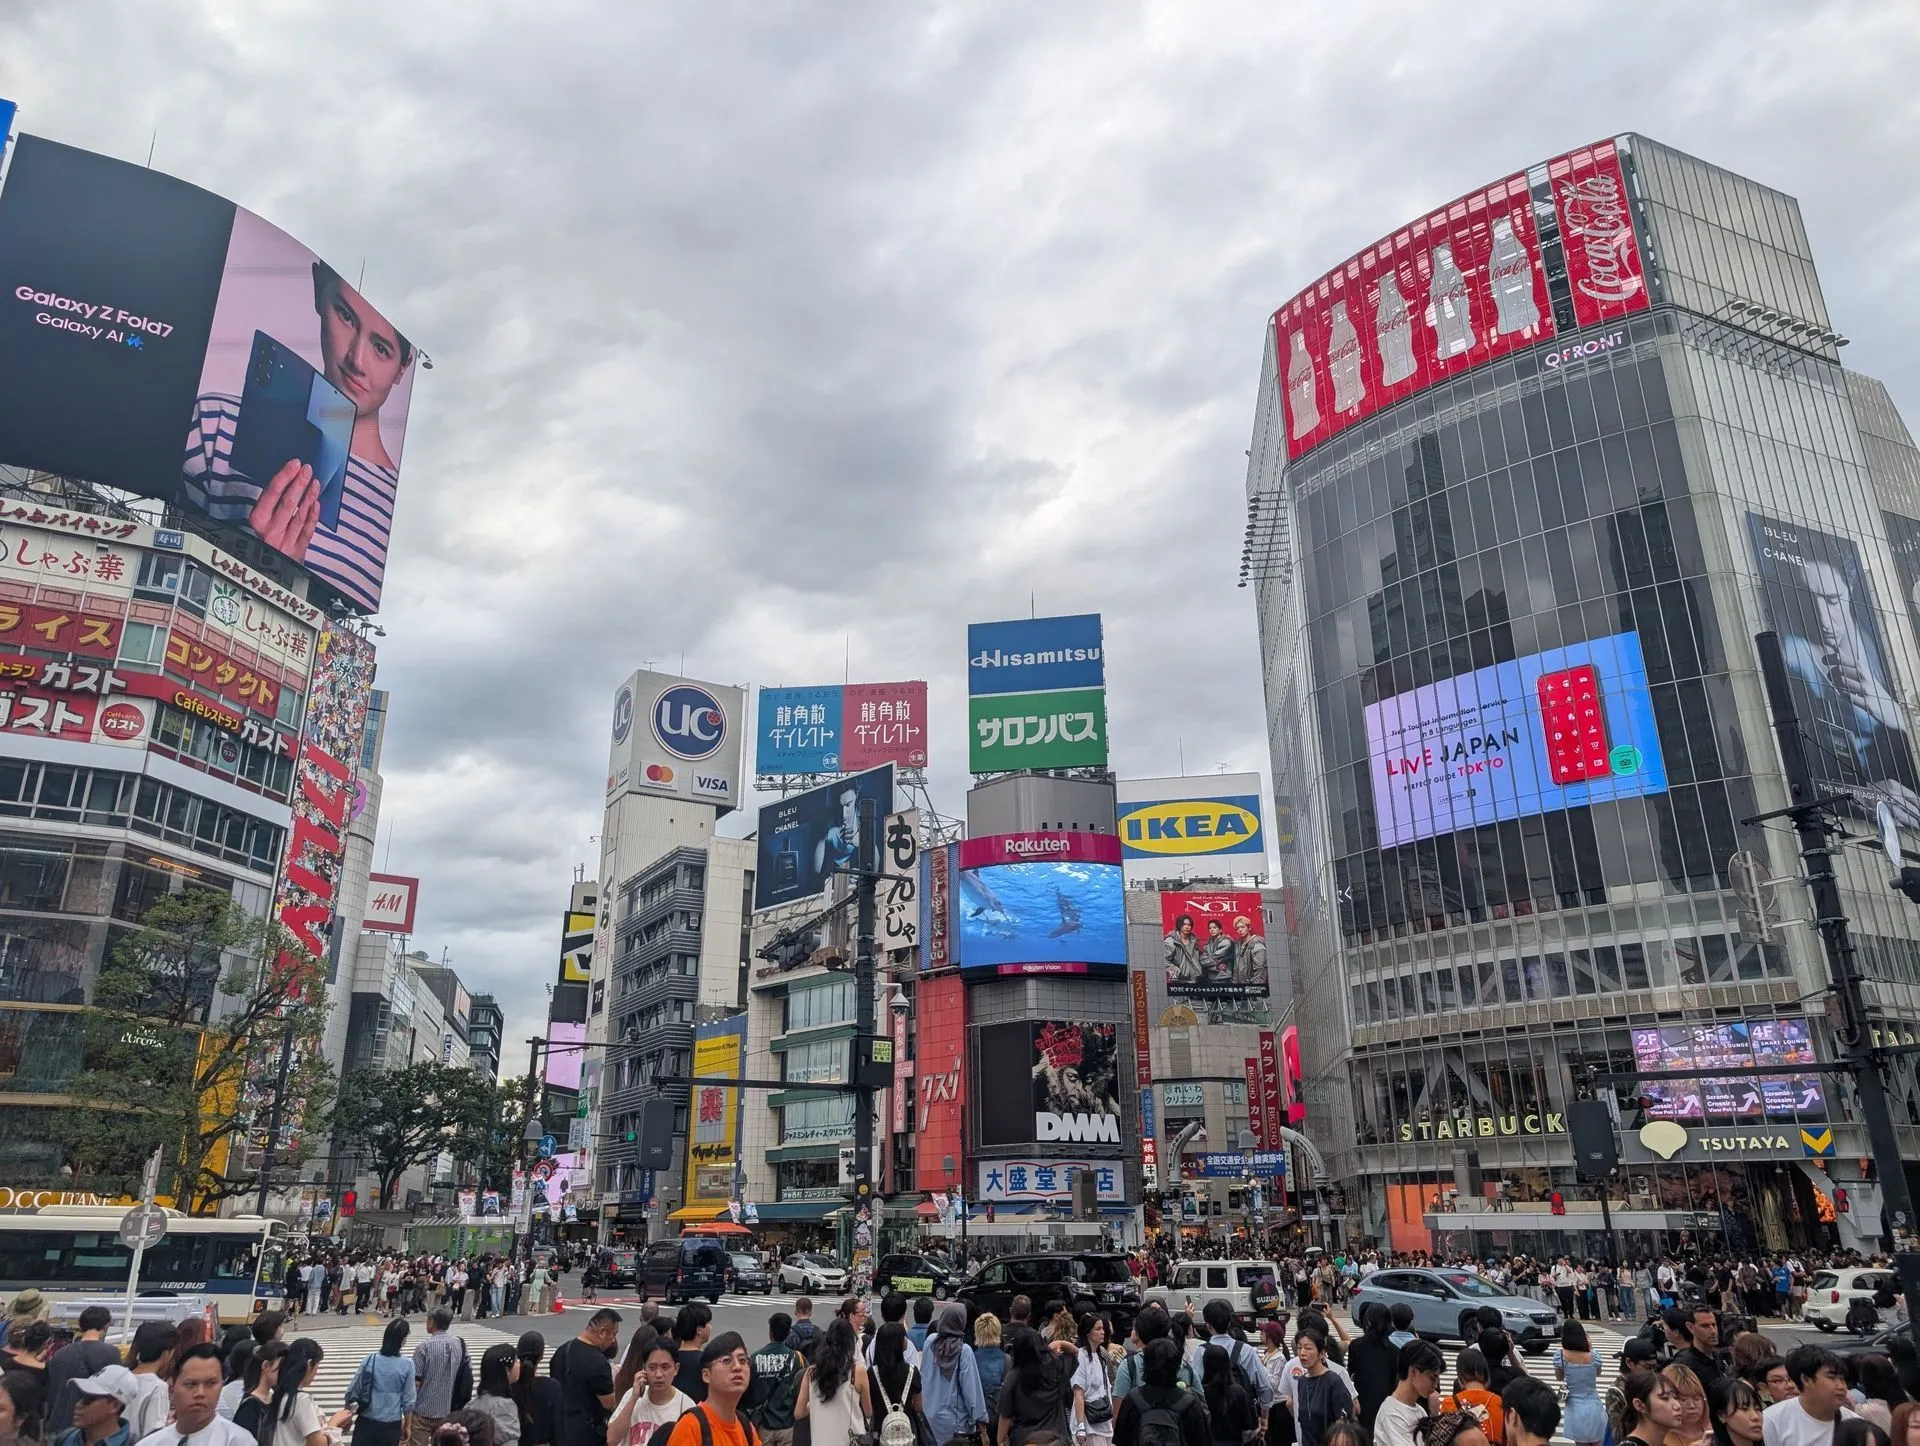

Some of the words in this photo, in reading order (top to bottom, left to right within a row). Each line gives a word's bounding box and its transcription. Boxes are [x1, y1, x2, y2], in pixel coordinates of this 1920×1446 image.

[15, 285, 98, 320] Galaxy
[99, 305, 113, 321] Z
[116, 310, 174, 339] Fold7
[35, 311, 103, 340] Galaxy
[106, 329, 124, 344] AI
[1545, 331, 1624, 368] QFRONT
[1764, 526, 1798, 543] BLEU
[16, 538, 125, 581] しゃぶ葉
[1763, 547, 1810, 568] CHANEL
[211, 549, 320, 622] しゃぶしゃぶバイキング
[244, 605, 309, 659] しゃぶ葉
[970, 647, 1101, 669] Hisamitsu
[40, 661, 127, 694] ガスト
[166, 635, 274, 705] コンタクト
[776, 703, 826, 727] 龍角散
[861, 700, 911, 723] 龍角散
[105, 718, 140, 731] ガスト
[174, 691, 204, 715] Café
[204, 706, 239, 731] レストラン
[241, 718, 289, 755] ガスト
[853, 723, 920, 745] ダイレクト
[977, 711, 1098, 748] サロンパス
[768, 727, 835, 749] ダイレクト
[1387, 748, 1432, 776] LIVE
[1440, 727, 1520, 763] JAPAN
[696, 776, 728, 792] VISA
[1403, 778, 1432, 791] PERFECT
[1433, 772, 1456, 783] GUIDE
[1457, 757, 1504, 777] TOKYO
[1819, 783, 1834, 793] THE
[778, 806, 798, 819] BLEU
[774, 821, 800, 834] CHANEL
[1126, 812, 1250, 841] IKEA
[1005, 838, 1070, 853] Rakuten
[886, 814, 917, 944] もんじゃ
[371, 892, 403, 913] H&M
[1022, 963, 1044, 971] Rakuten
[1045, 963, 1062, 971] Vision
[1637, 1034, 1656, 1046] 2F
[1693, 1030, 1713, 1042] 3F
[1753, 1025, 1773, 1038] 4F
[1261, 1039, 1278, 1100] カラオケ
[919, 1055, 961, 1133] クスリ
[1165, 1095, 1203, 1105] クリニック
[1174, 1084, 1202, 1094] れいわ
[699, 1087, 723, 1123] 薬
[1035, 1111, 1121, 1142] DMM
[1250, 1104, 1264, 1147] カラオ
[1143, 1143, 1155, 1163] 焼肉
[1699, 1136, 1790, 1151] TSUTAYA
[160, 1281, 185, 1289] KEIO
[184, 1281, 207, 1289] BUS
[1256, 1295, 1279, 1303] SUZUKI
